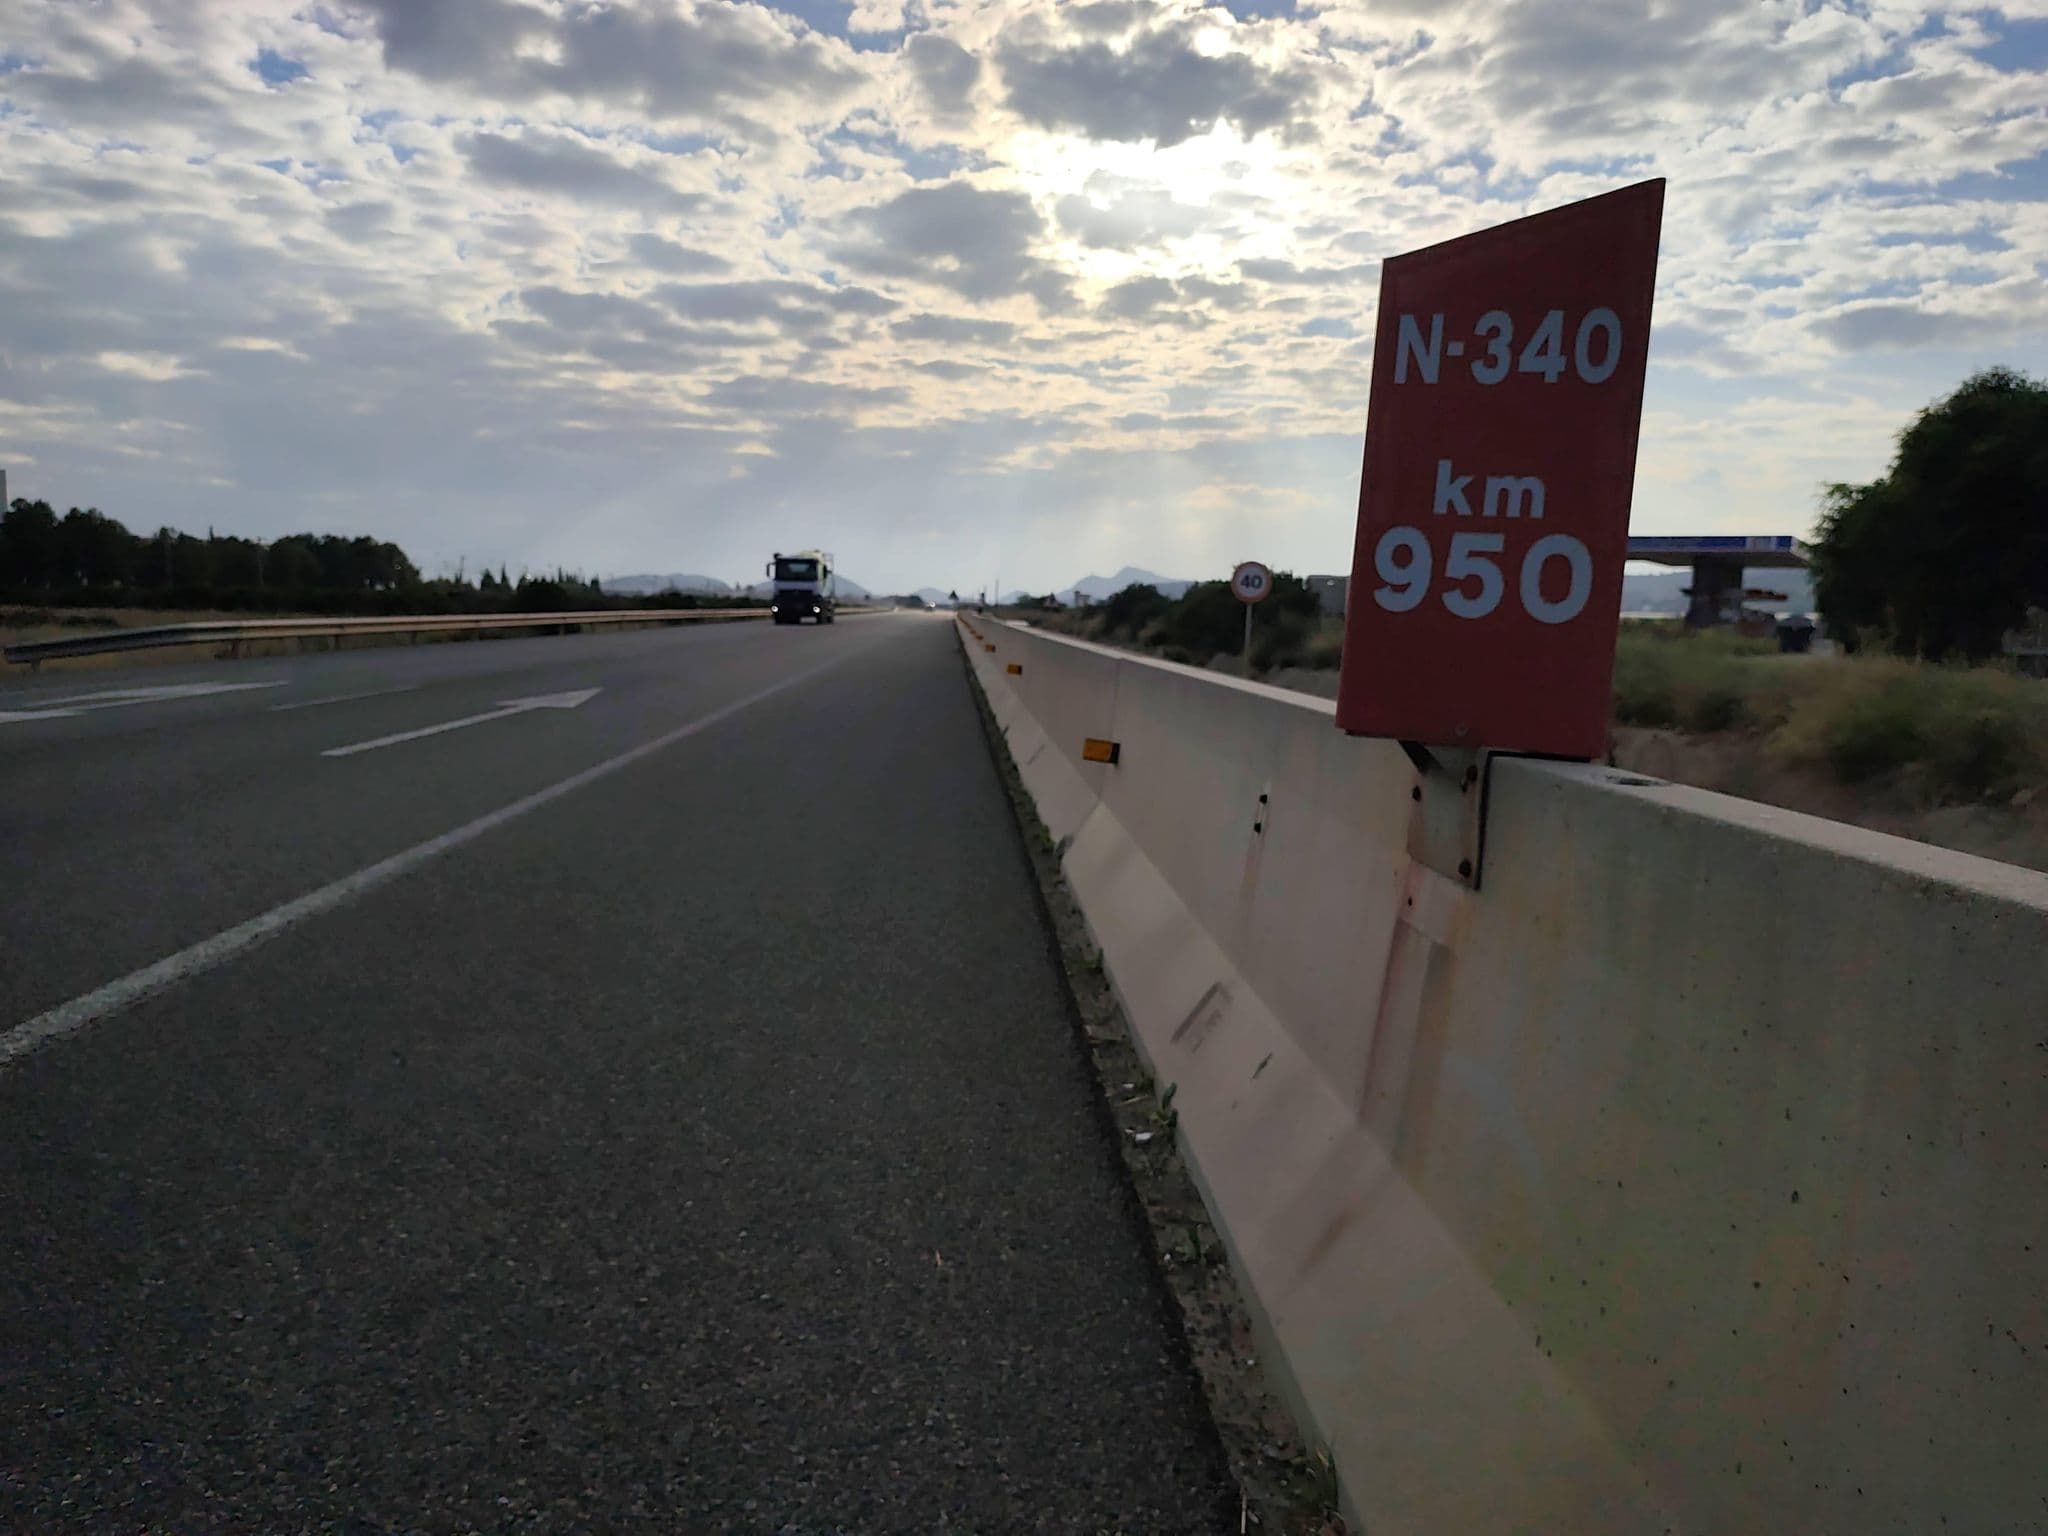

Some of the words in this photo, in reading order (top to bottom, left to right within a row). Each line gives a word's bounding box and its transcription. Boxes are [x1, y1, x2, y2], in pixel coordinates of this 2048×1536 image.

[1394, 308, 1622, 384] N-340
[1433, 459, 1546, 518] km
[1240, 574, 1263, 589] 40
[1373, 526, 1594, 624] 950
